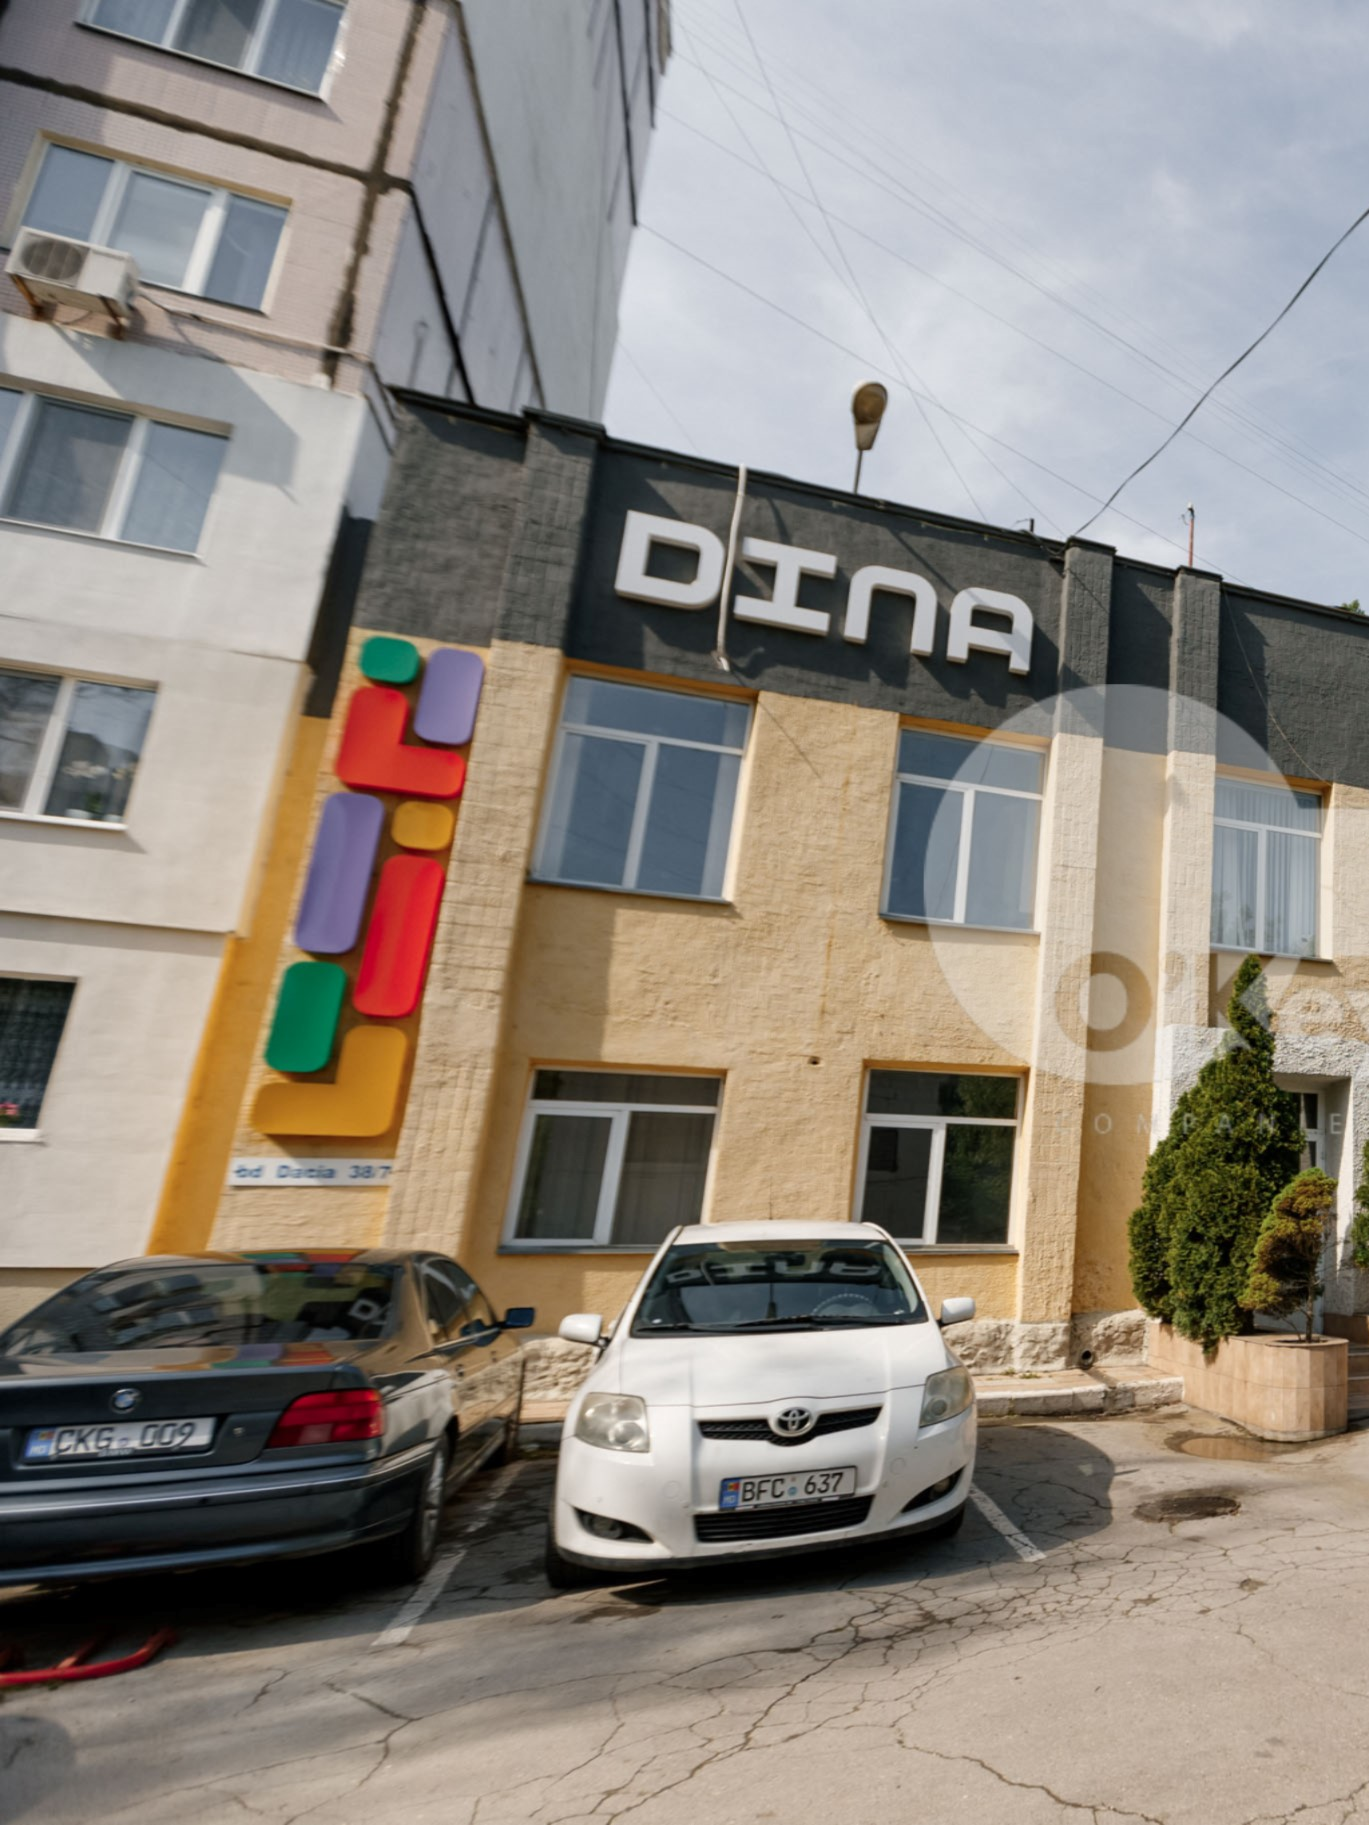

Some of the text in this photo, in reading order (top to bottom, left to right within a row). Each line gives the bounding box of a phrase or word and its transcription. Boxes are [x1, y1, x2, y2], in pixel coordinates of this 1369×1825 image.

[614, 510, 1035, 676] DINA
[276, 1164, 336, 1179] Dacia
[55, 1422, 196, 1454] CKG 009
[741, 1472, 844, 1502] BFC 637
